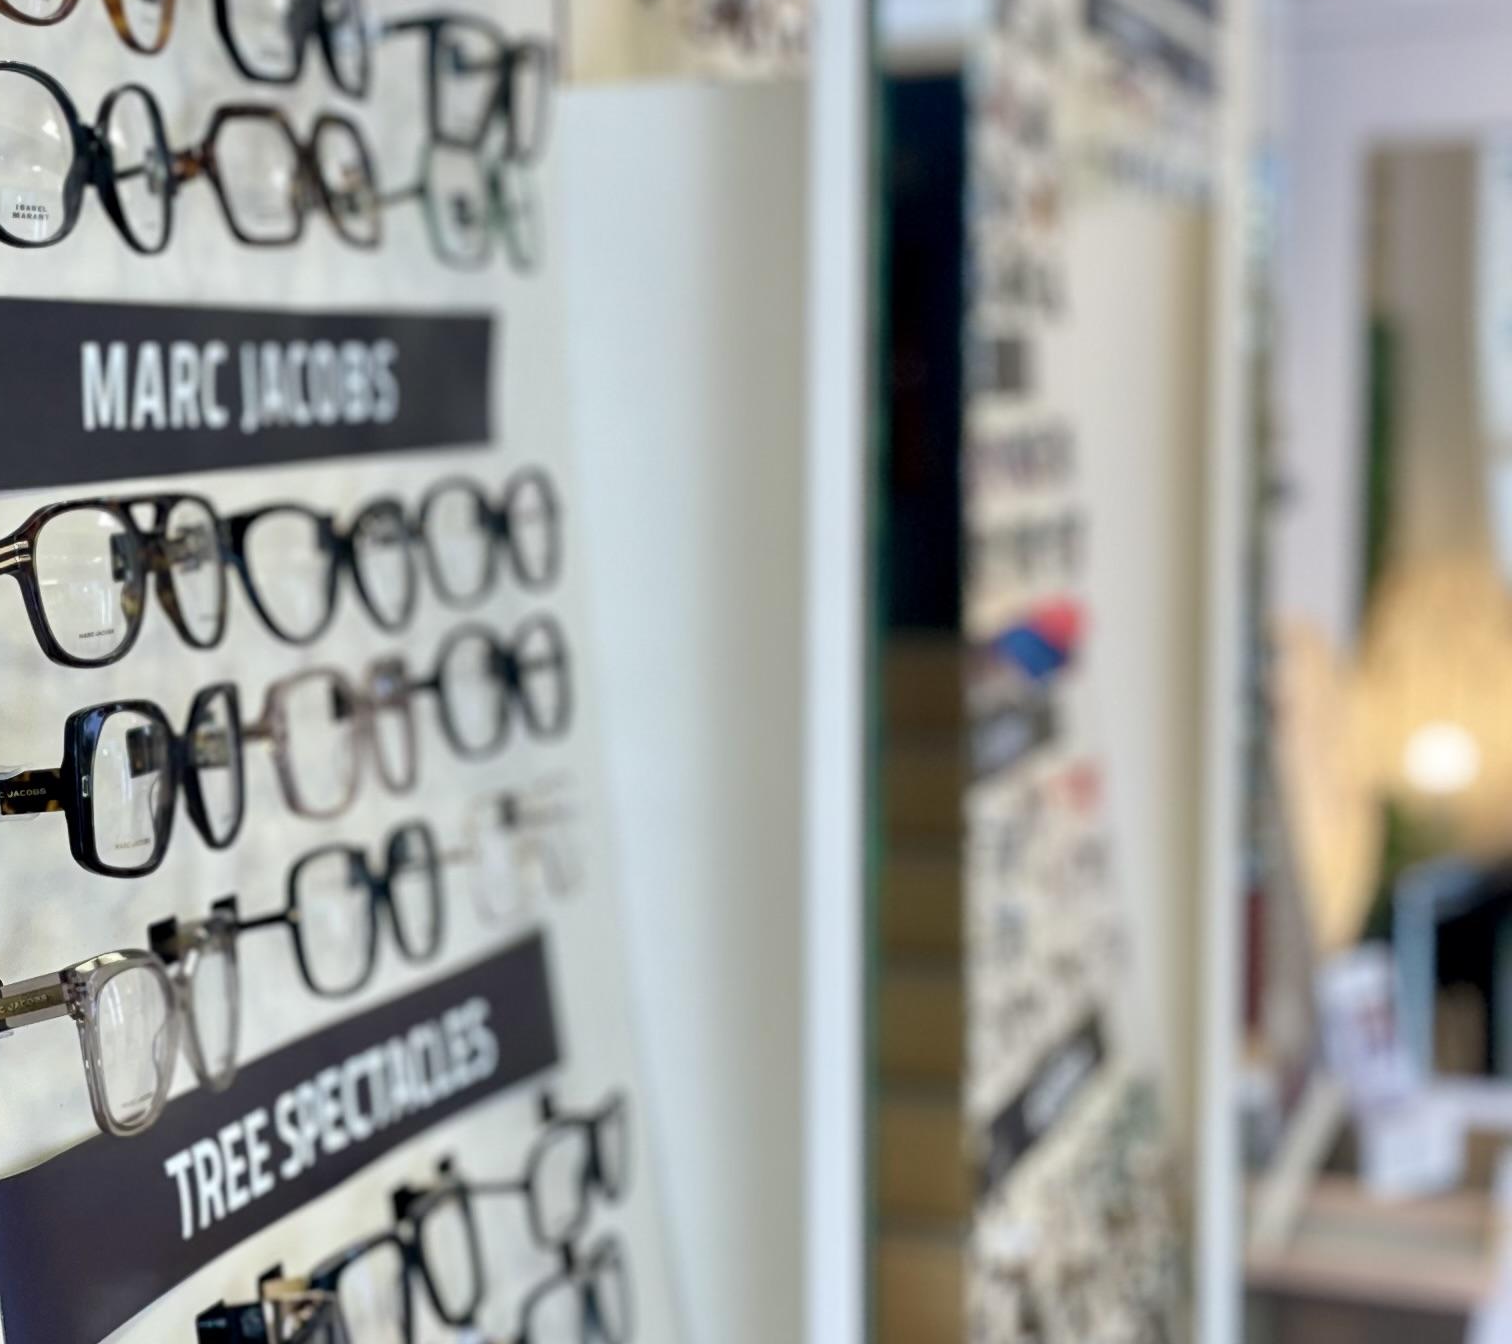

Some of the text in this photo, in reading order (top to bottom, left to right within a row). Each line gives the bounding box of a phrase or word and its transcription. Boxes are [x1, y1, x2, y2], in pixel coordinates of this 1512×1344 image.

[80, 339, 401, 437] MARC JACOBS
[164, 993, 500, 1240] TREE SPECTACLES
